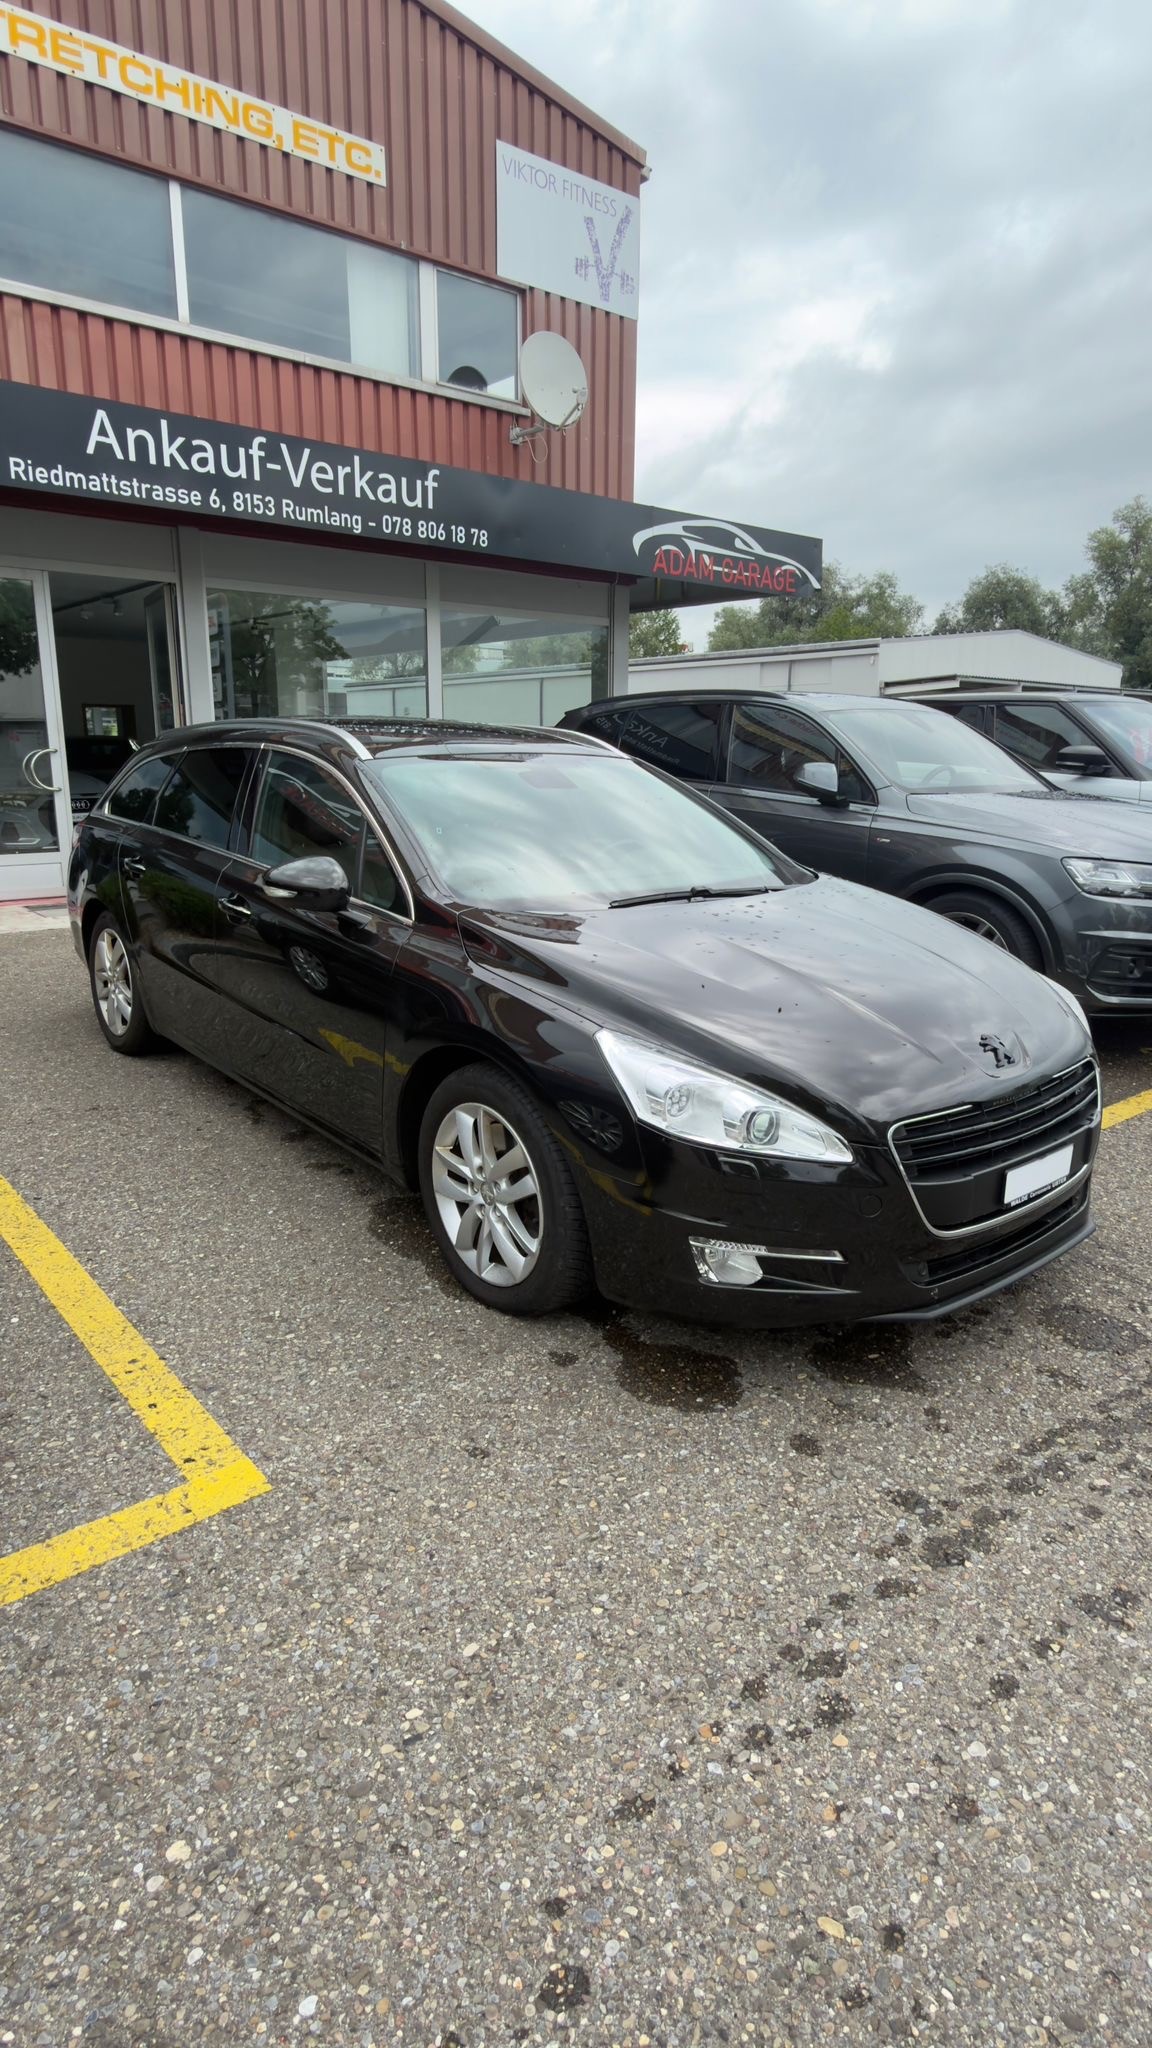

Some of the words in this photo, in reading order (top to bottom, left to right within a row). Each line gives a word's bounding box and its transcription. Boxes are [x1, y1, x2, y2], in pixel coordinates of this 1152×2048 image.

[292, 119, 382, 178] ETC.
[502, 154, 558, 194] VIKTOR
[562, 179, 617, 217] FITNESS
[86, 409, 440, 509] Ankauf-Verkauf
[8, 456, 202, 506] Riedmattstrasse
[209, 488, 226, 513] 6,
[233, 491, 275, 517] 8153
[282, 499, 362, 534] Rumlang
[382, 515, 412, 537] 078
[418, 520, 446, 541] 806
[451, 525, 466, 544] 18
[471, 529, 489, 547] 78
[652, 547, 715, 582] ADAM
[721, 558, 796, 593] GARAGE
